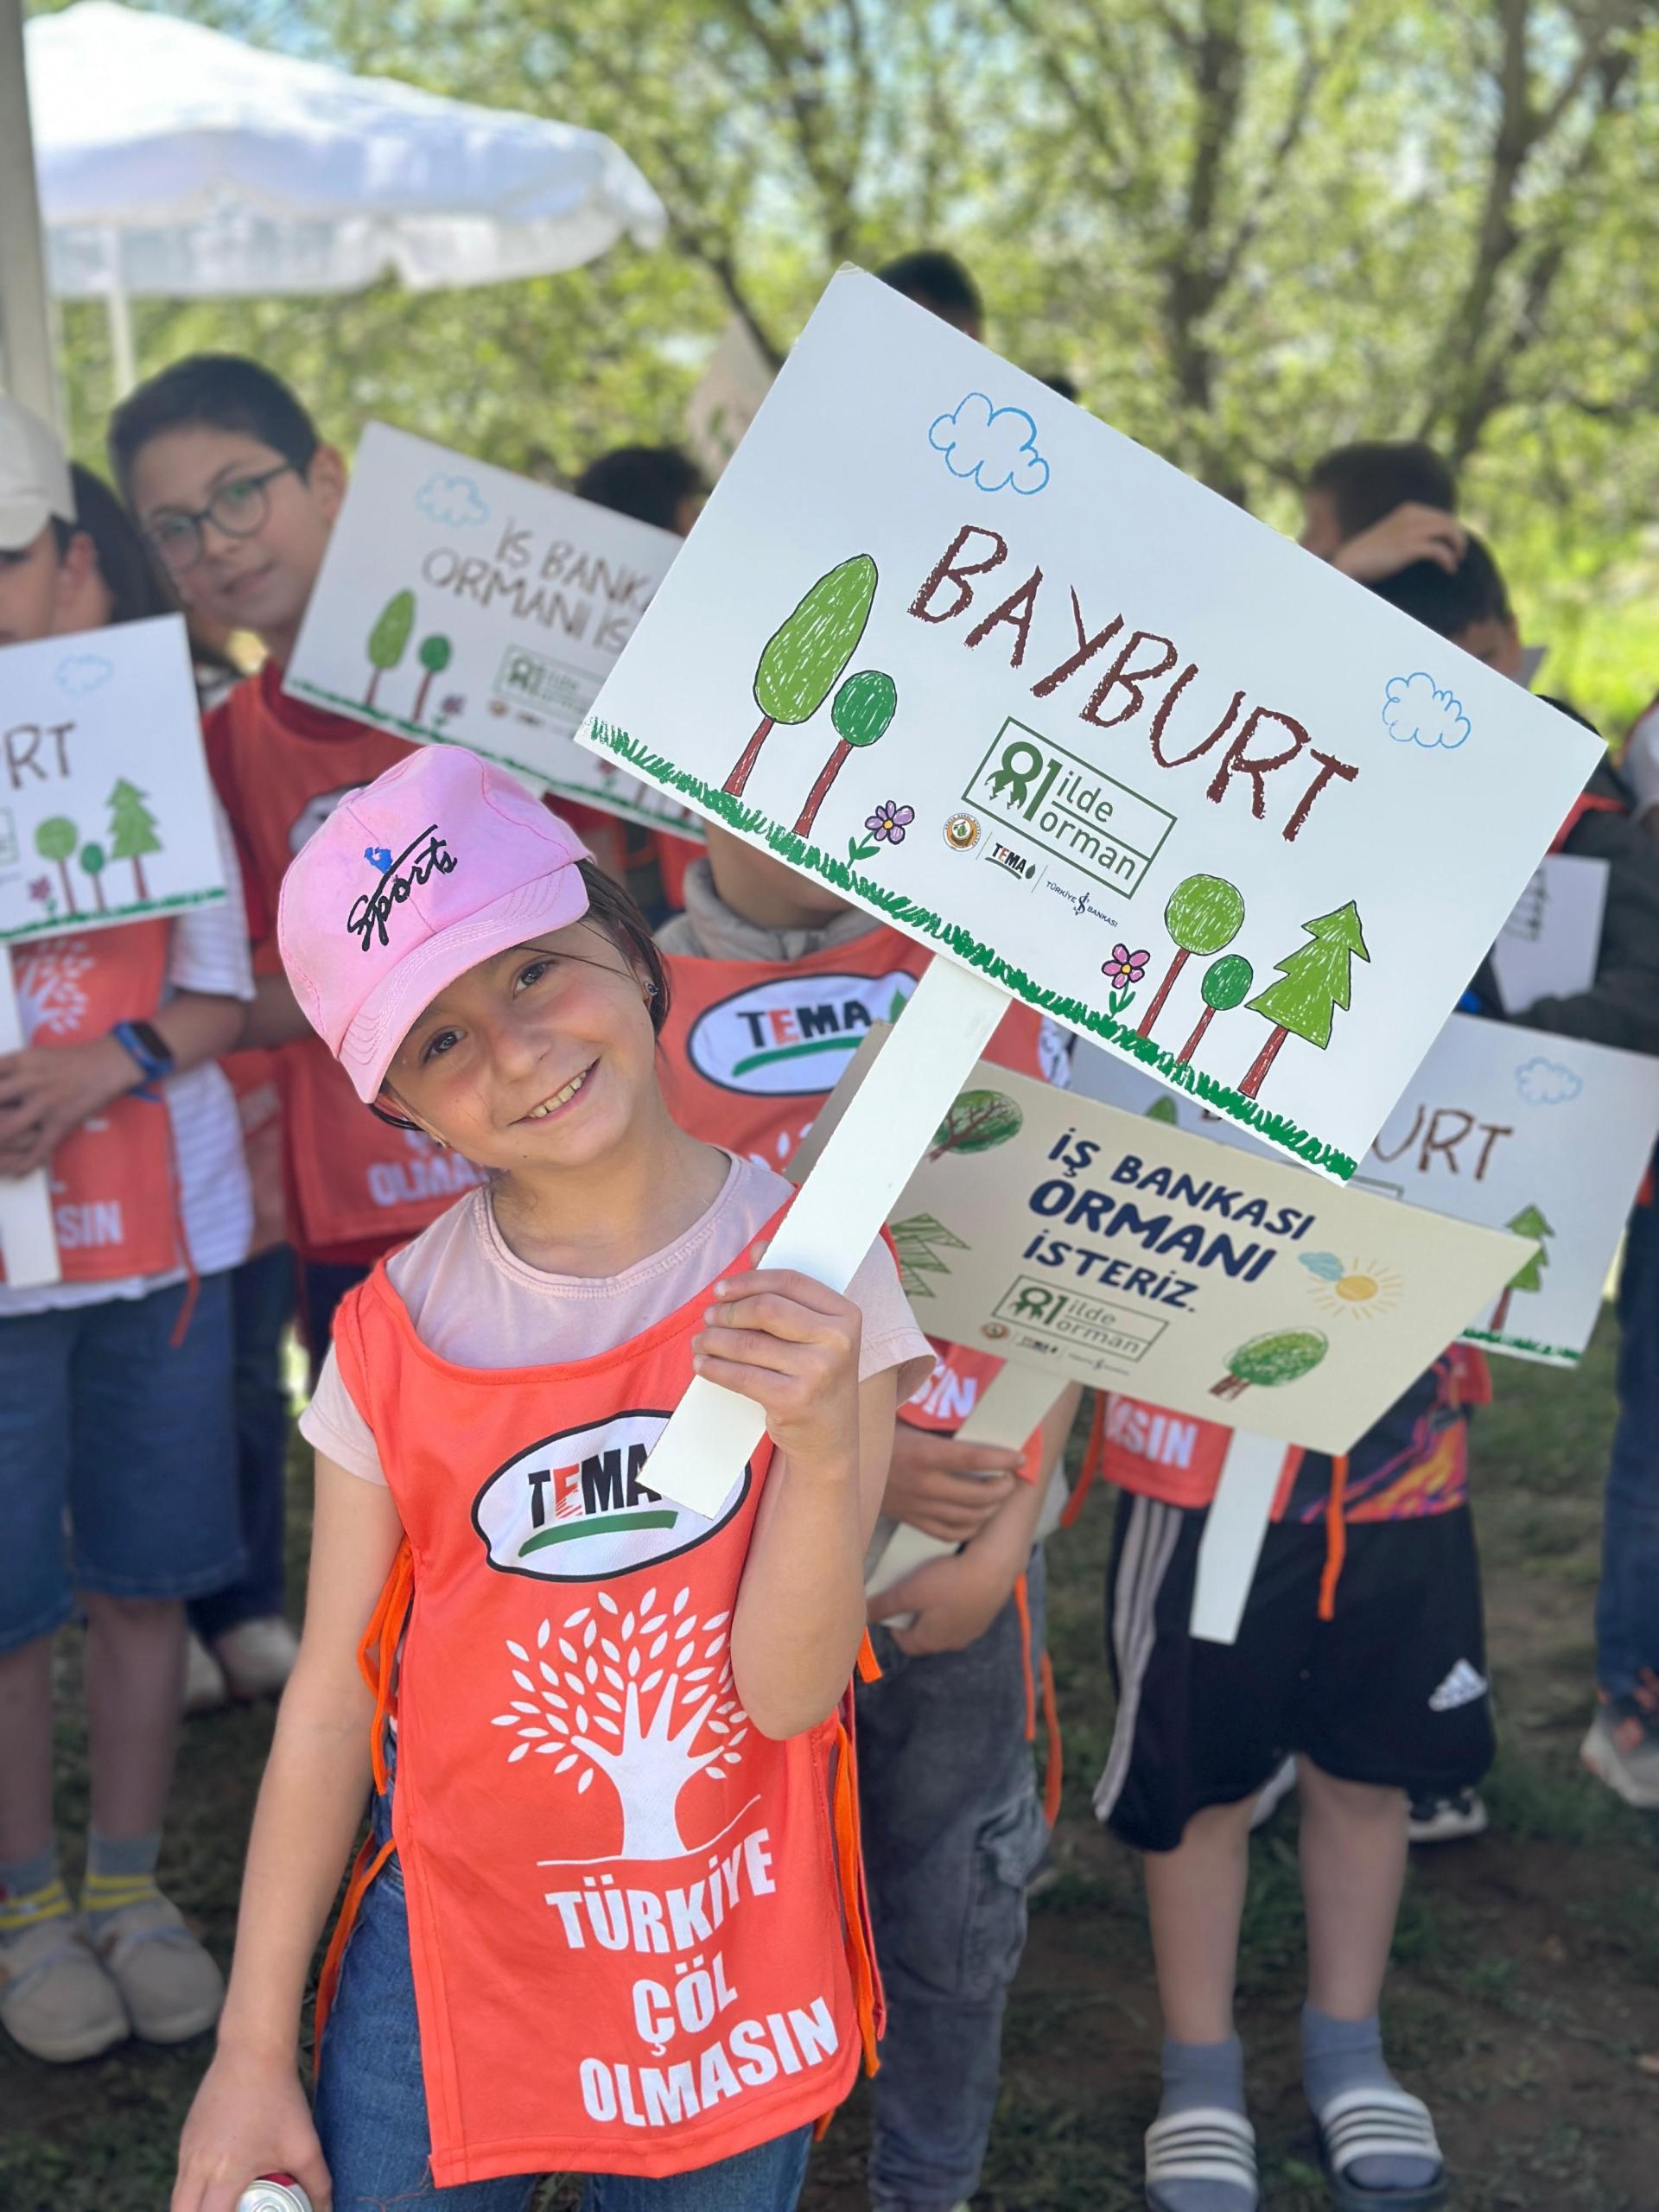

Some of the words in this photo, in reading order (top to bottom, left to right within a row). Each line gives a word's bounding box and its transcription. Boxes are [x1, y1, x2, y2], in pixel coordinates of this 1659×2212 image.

[539, 540, 650, 613] BANK
[907, 524, 1359, 842] BAYBURT
[1057, 770, 1114, 823] ilde
[992, 842, 1027, 874] TEMA
[1039, 810, 1136, 880] orman
[347, 823, 458, 951] Sports
[1046, 880, 1077, 904] TÜRKİYE
[1086, 905, 1118, 928] BANKASI
[737, 1000, 872, 1048] TEMA
[367, 1153, 490, 1206] OLMA
[1048, 1128, 1101, 1178] İŞ
[1110, 1154, 1316, 1240] BANKASI
[1028, 1179, 1277, 1282] ORMANI
[1023, 1229, 1199, 1313] İSTERİZ.
[1056, 1319, 1140, 1354] orman
[1068, 1300, 1116, 1325] ilde
[528, 1443, 662, 1529] TEMA
[544, 1827, 776, 1954] TÜRKİYE
[632, 1950, 738, 2056] ÇÖL
[579, 1996, 839, 2126] OLMASIN
